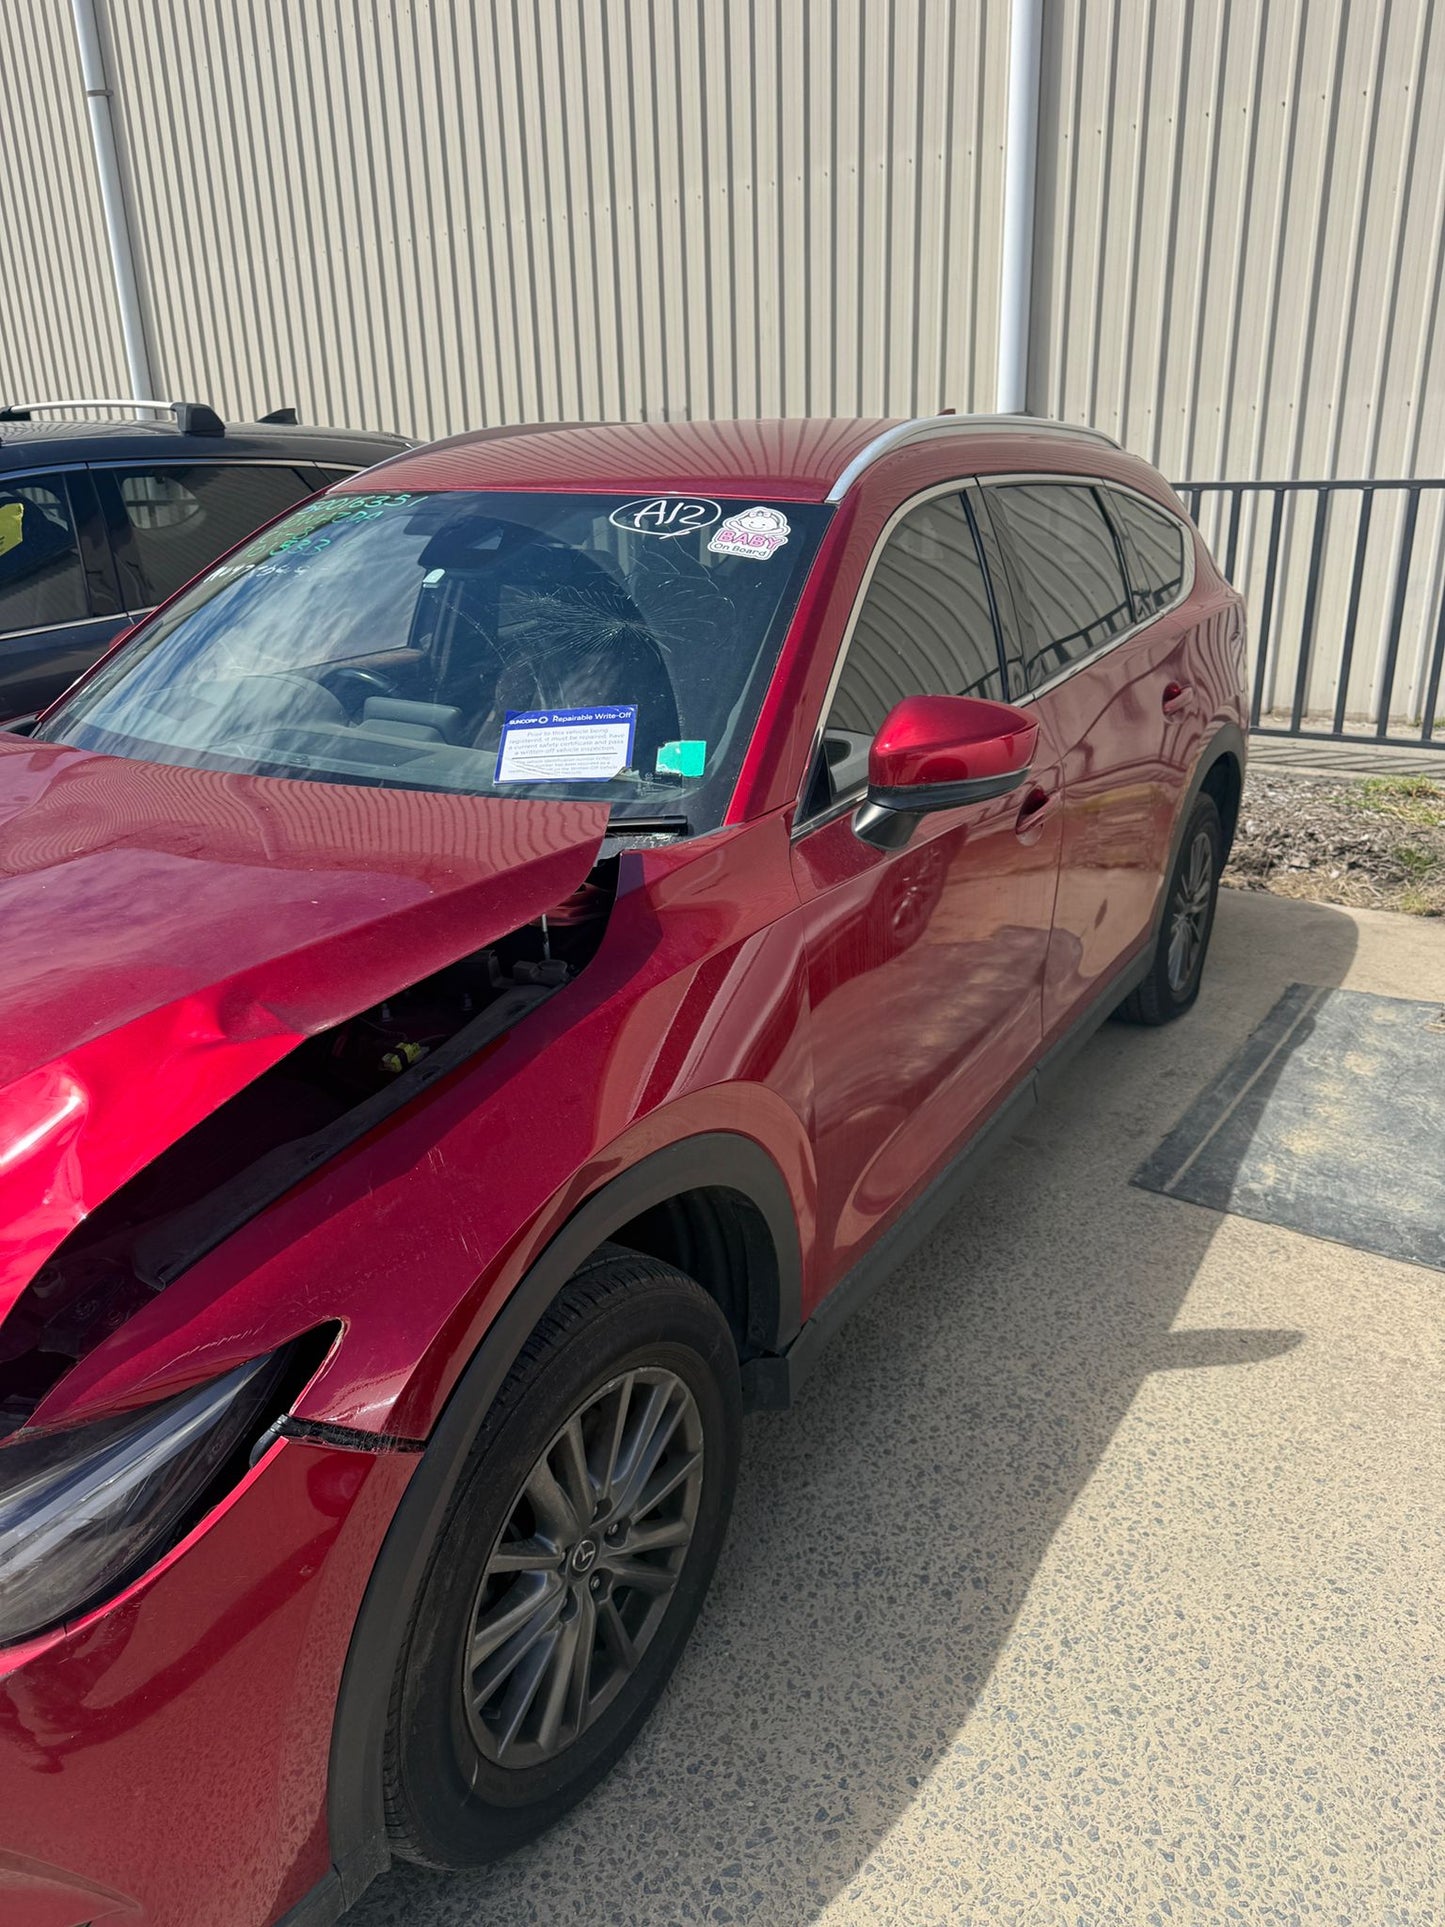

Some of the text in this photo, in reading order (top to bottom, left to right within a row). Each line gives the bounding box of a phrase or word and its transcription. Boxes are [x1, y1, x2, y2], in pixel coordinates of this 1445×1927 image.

[717, 529, 784, 550] BABY
[714, 543, 768, 557] On Board
[509, 717, 538, 725] SUNCORP
[552, 711, 632, 724] Repairable Write-Off
[560, 740, 593, 748] certificate
